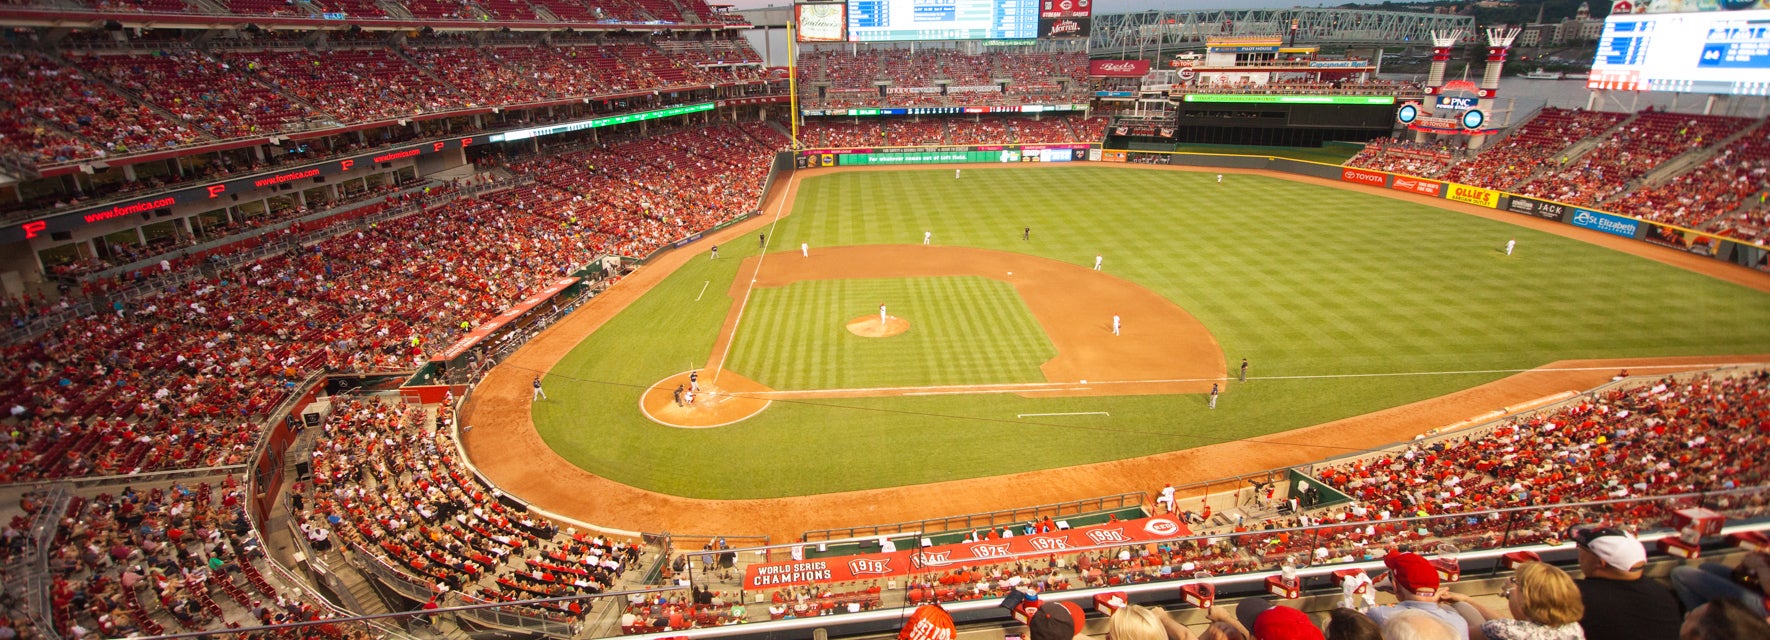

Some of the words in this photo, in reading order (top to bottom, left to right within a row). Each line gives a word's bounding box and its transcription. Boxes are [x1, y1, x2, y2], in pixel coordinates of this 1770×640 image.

[1450, 98, 1471, 107] PNC
[254, 168, 320, 187] www.formica.com
[1356, 173, 1383, 184] TOYOTA
[84, 195, 175, 223] www.formica.com
[1538, 203, 1561, 214] JACK
[1598, 218, 1636, 232] Elizabeth
[1089, 530, 1122, 542] 1990
[1032, 537, 1067, 550] 1976
[974, 545, 1006, 558] 1975
[758, 566, 791, 576] WORLD
[793, 562, 827, 572] SERIES
[851, 560, 883, 573] 1919
[753, 570, 831, 586] CHAMPIONS
